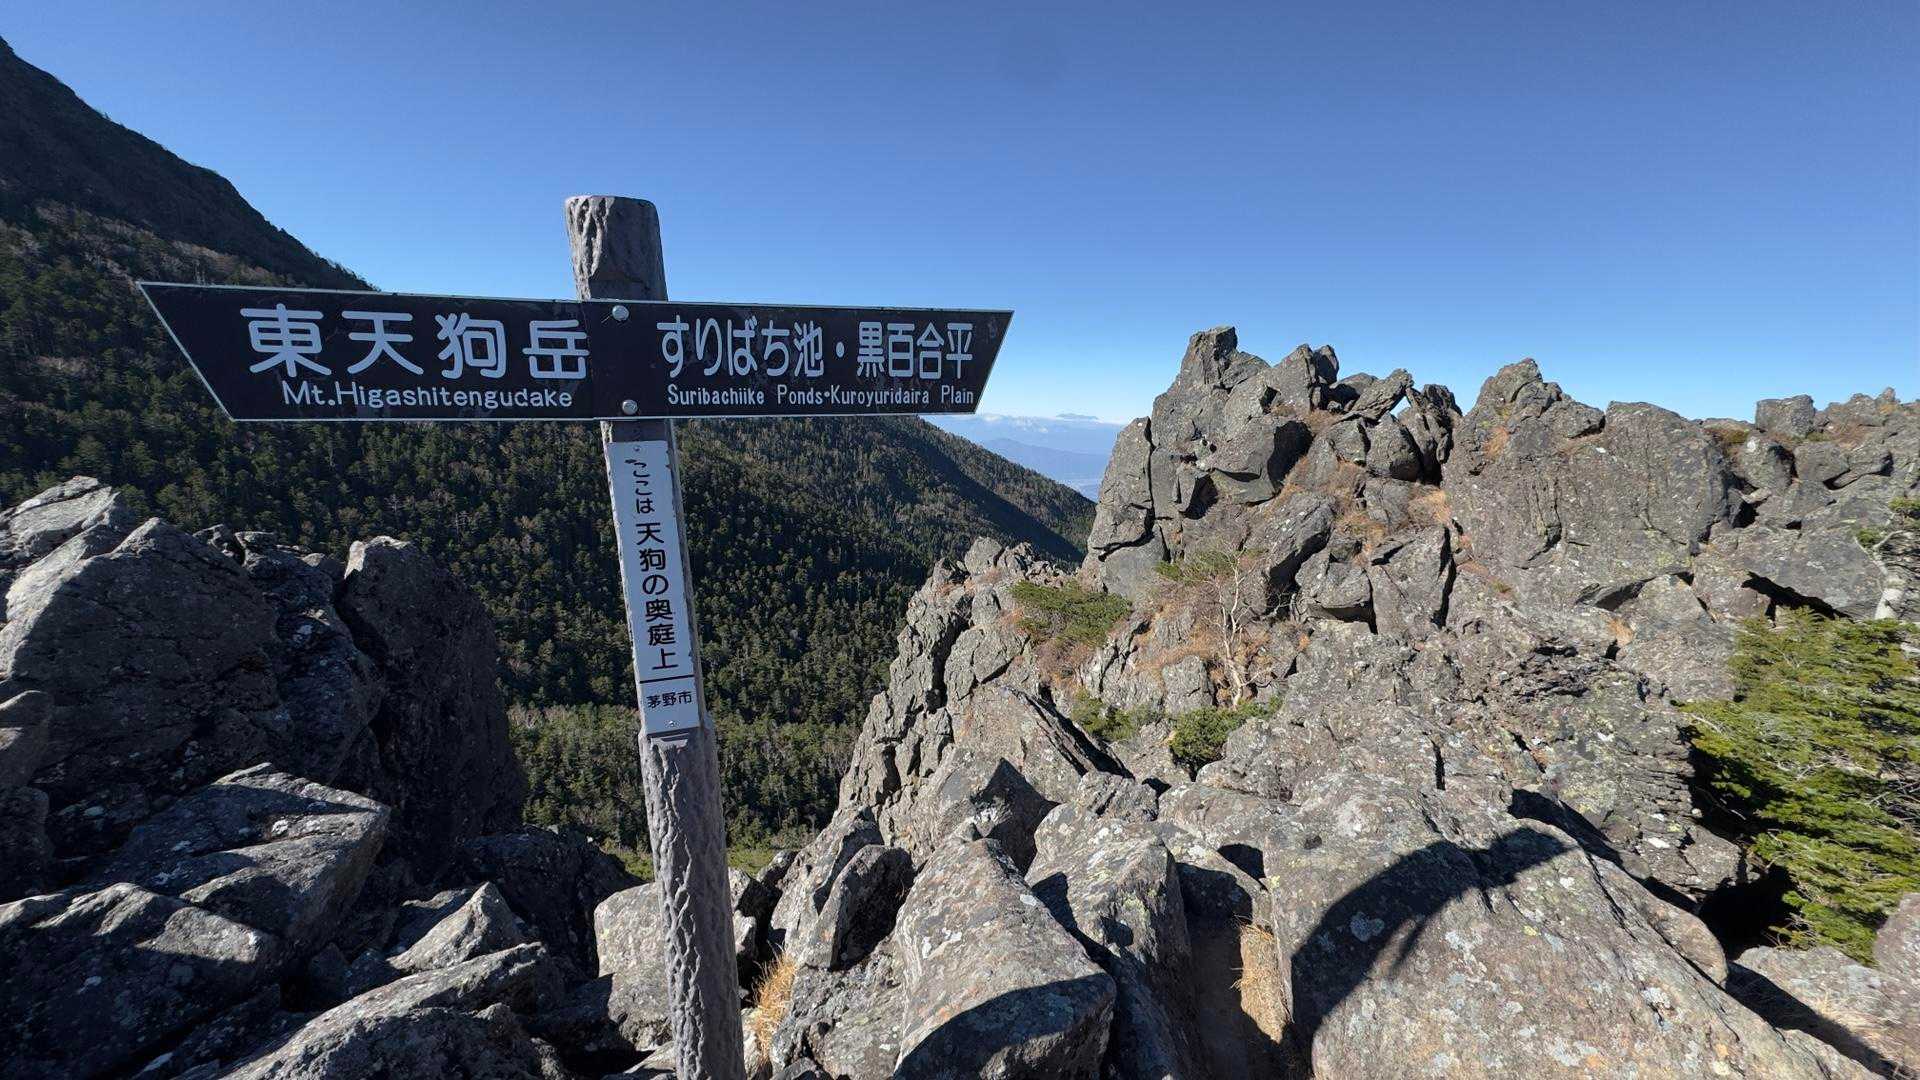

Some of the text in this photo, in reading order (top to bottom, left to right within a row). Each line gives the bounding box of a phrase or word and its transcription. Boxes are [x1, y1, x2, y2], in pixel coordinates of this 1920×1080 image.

[240, 303, 589, 379] 東天狗岳
[282, 380, 573, 410] Mt.Higashitengudake
[667, 383, 765, 405] Suribachiike
[941, 384, 974, 405] Plain
[646, 691, 692, 709] 茅野市
